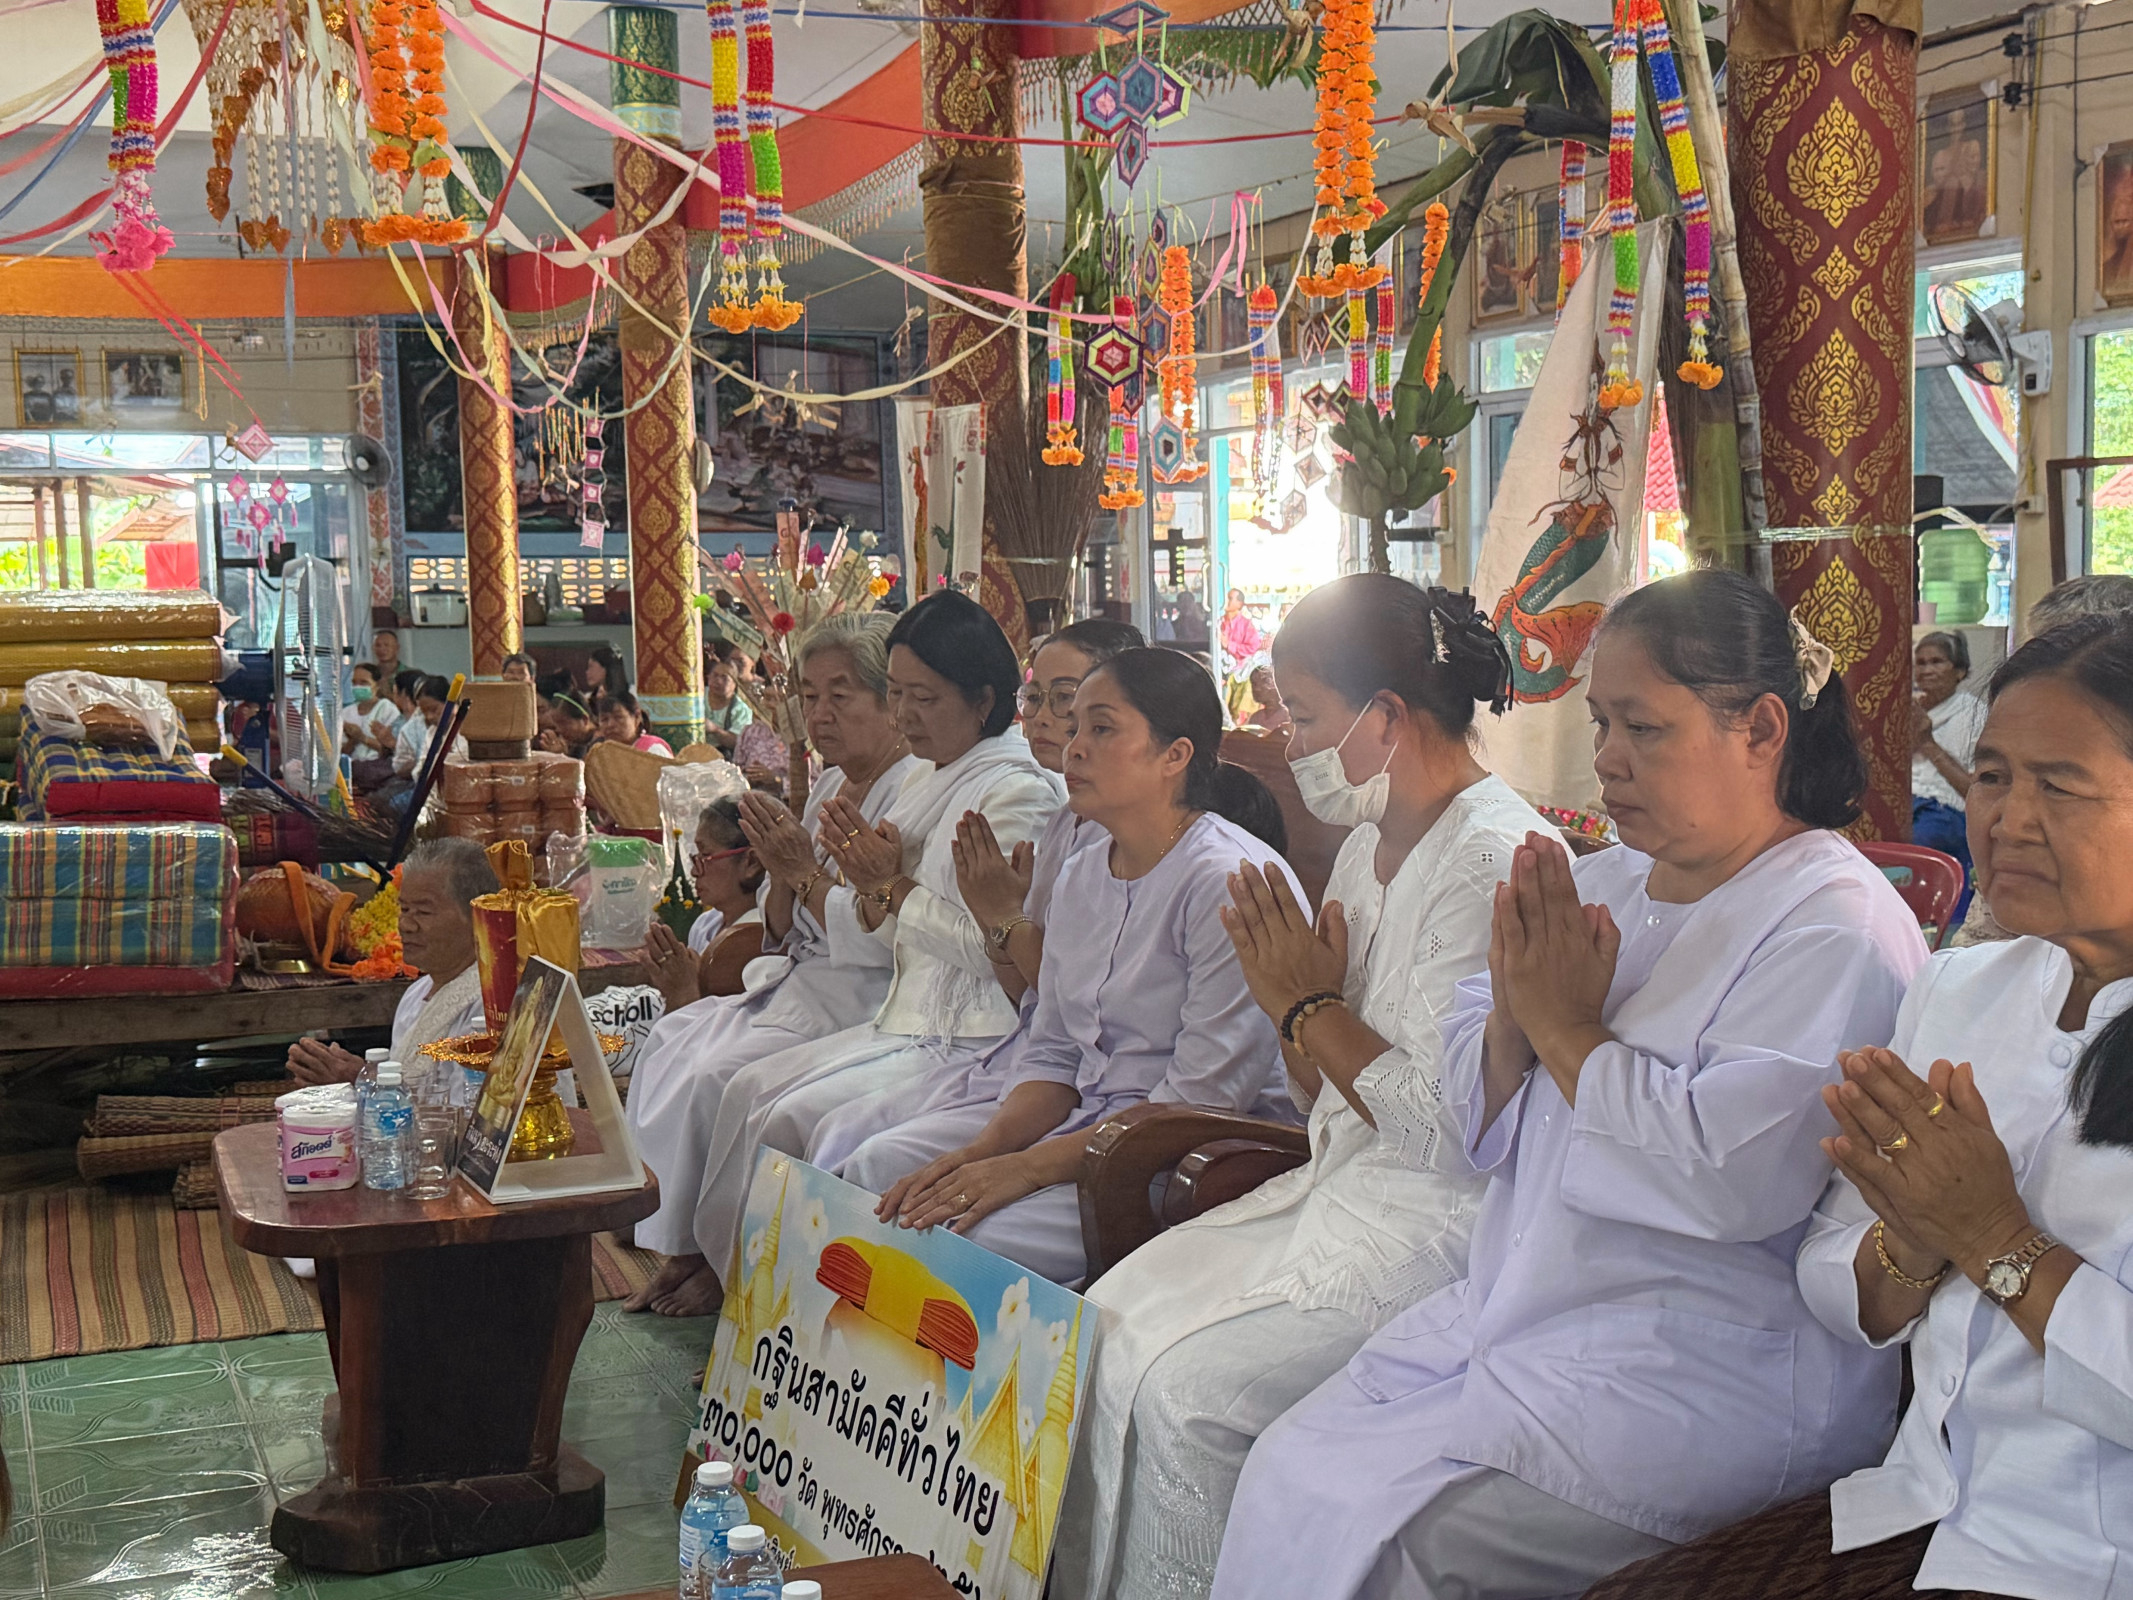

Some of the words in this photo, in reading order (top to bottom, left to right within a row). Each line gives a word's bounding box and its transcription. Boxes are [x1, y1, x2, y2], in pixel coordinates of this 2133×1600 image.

[590, 995, 653, 1027] scholl
[752, 1324, 1000, 1537] กฐินสามัคคีทั่วไทย
[797, 1456, 819, 1511] วัด
